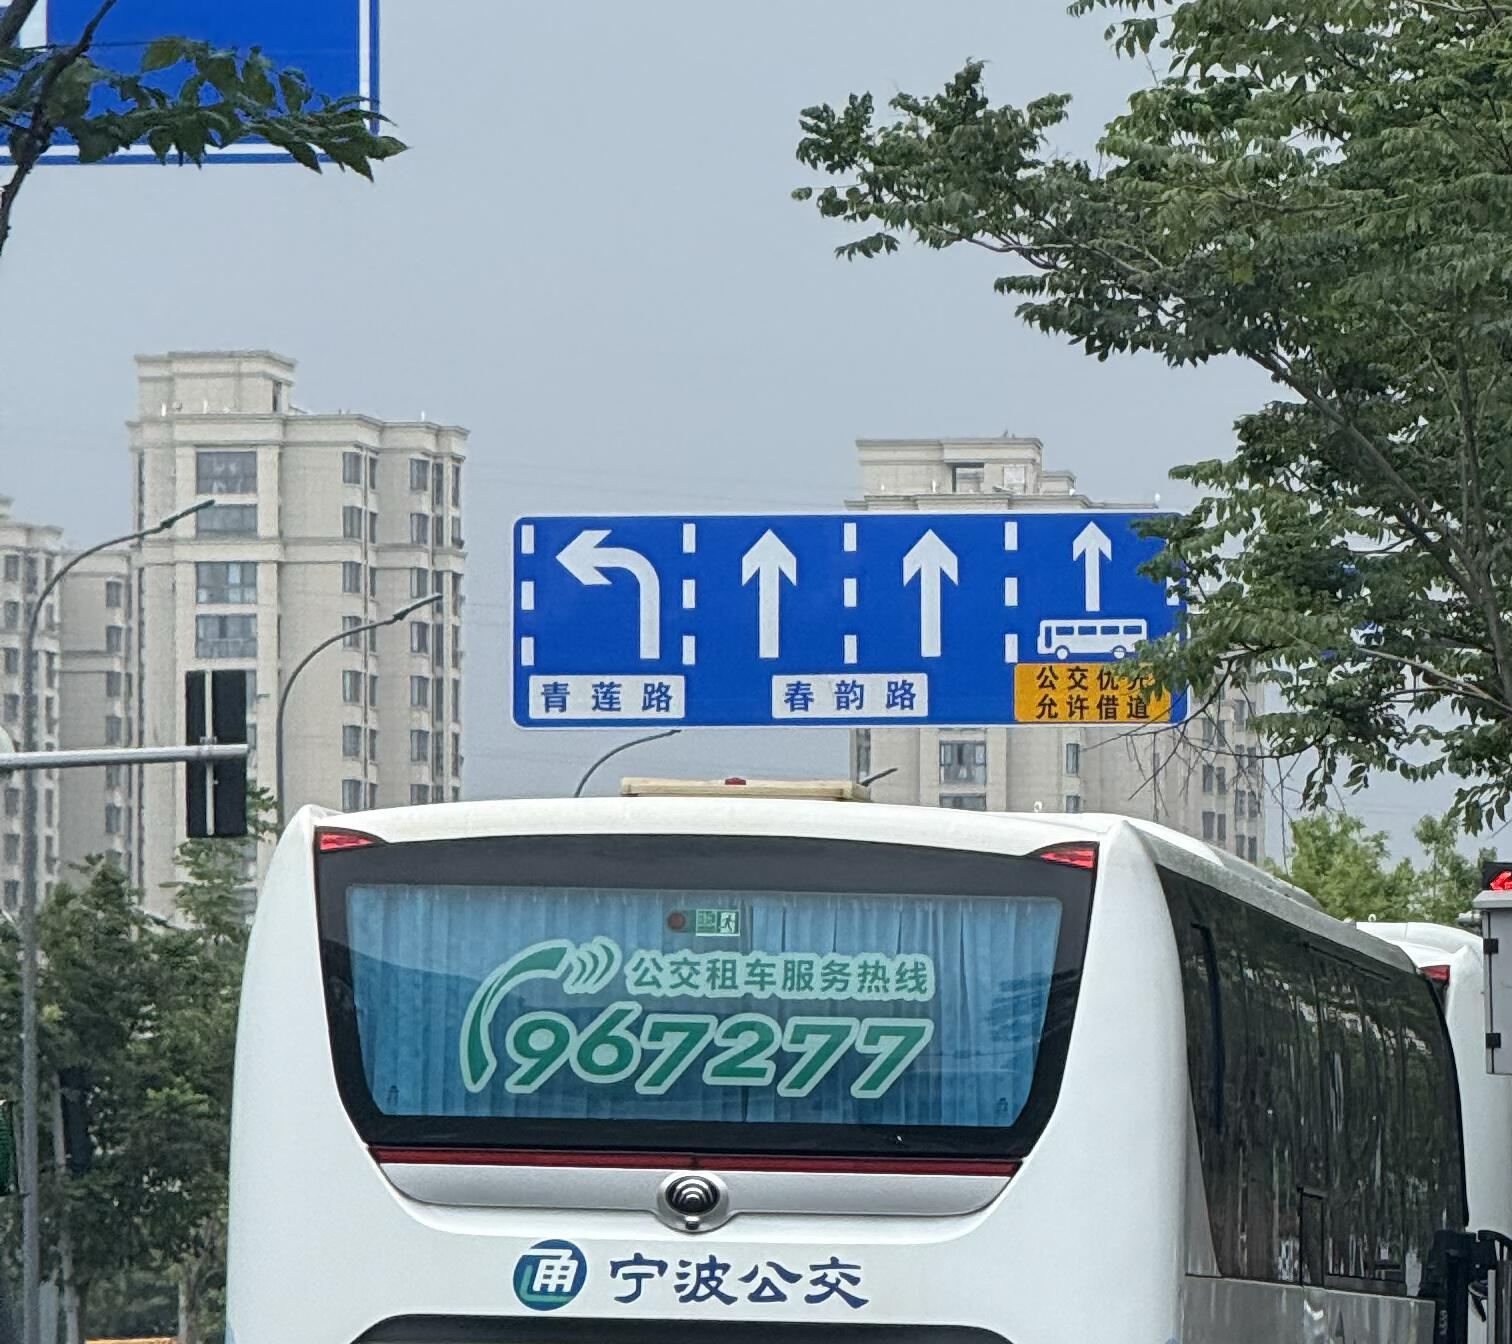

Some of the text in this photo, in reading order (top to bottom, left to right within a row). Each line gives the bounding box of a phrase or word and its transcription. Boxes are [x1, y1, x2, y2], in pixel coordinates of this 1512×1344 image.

[540, 681, 673, 713] 青莲路
[783, 680, 917, 712] 春韵路
[1035, 692, 1150, 721] 允许借道
[630, 956, 930, 996] 公交租车服务热线
[509, 1005, 929, 1093] 967277
[608, 1251, 870, 1310] 宁波公交
